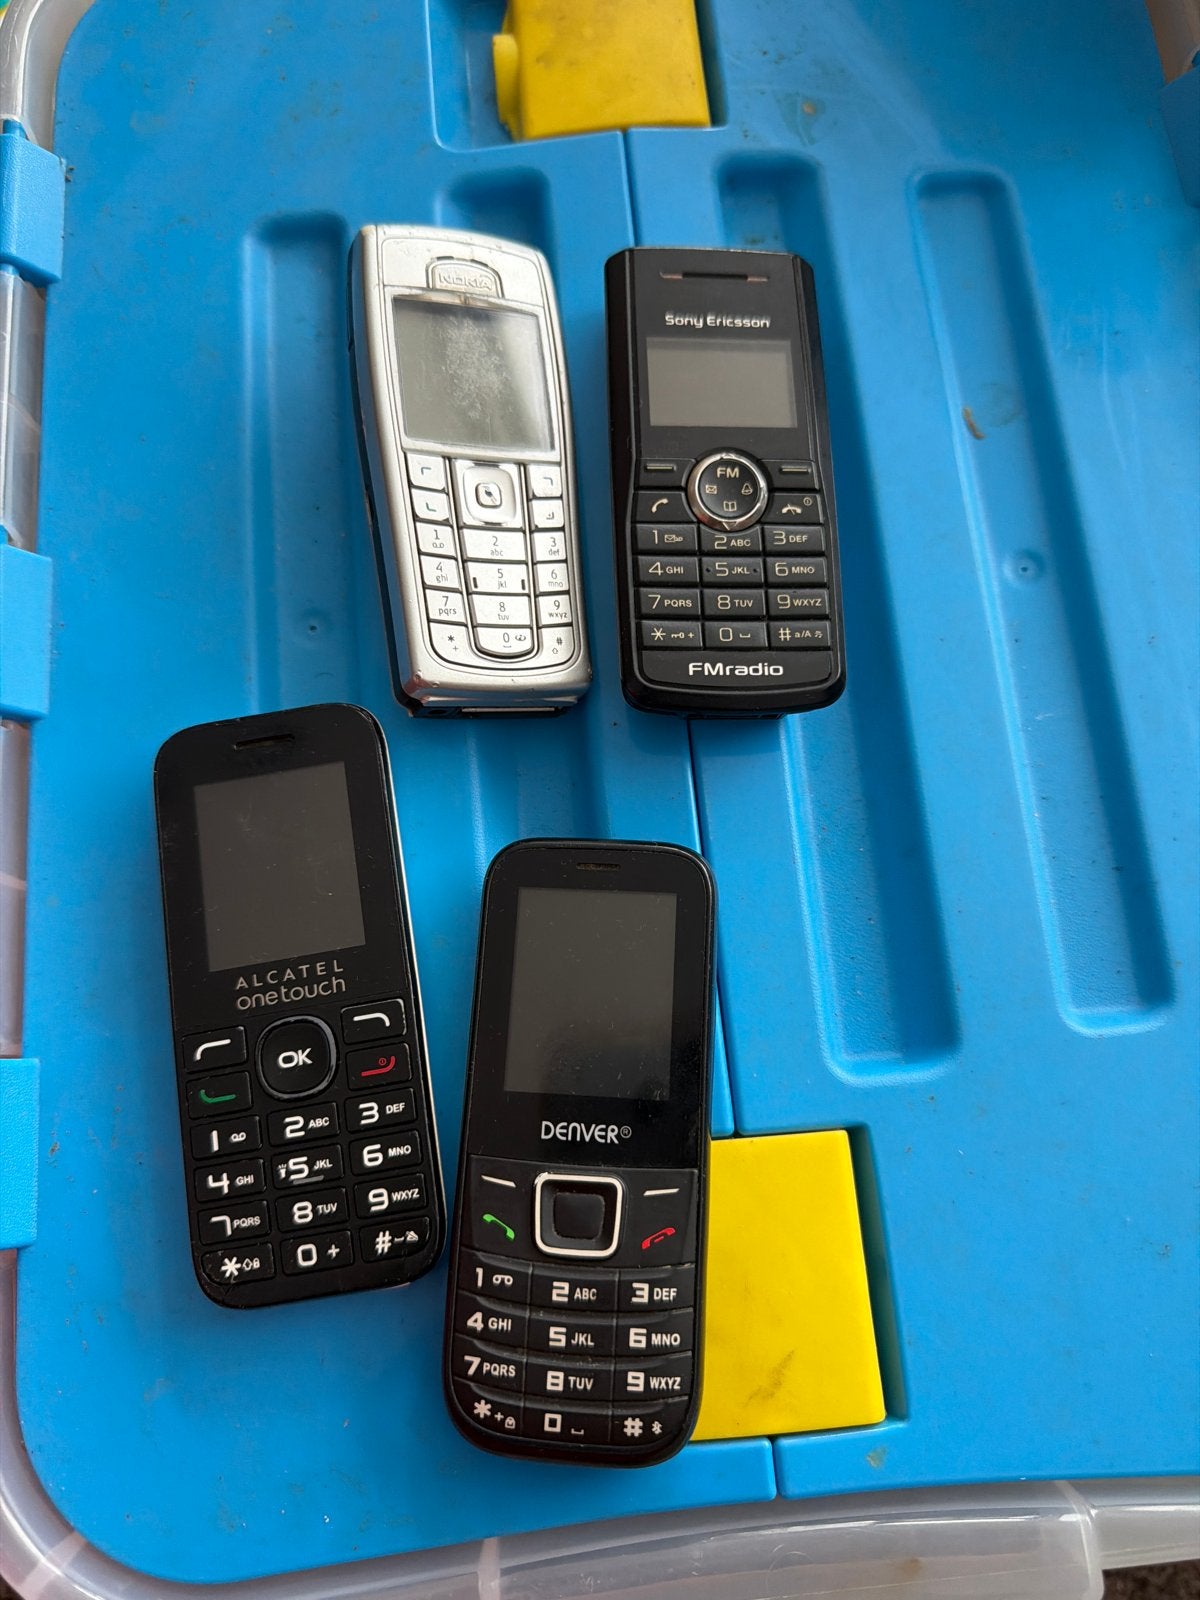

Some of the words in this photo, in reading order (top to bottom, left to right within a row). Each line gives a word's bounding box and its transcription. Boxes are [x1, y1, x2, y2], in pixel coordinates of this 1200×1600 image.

[438, 272, 494, 290] NOKIA
[665, 312, 704, 329] Sony
[706, 313, 771, 329] Ericsson
[716, 467, 739, 479] FM
[492, 536, 498, 546] 2
[550, 537, 557, 547] 3
[652, 530, 658, 545] 1
[715, 536, 727, 549] 2
[730, 539, 751, 547] ABC
[773, 531, 786, 545] 3
[436, 561, 443, 573] 4
[497, 568, 504, 579] 5
[551, 569, 557, 579] 6
[648, 562, 663, 575] 4
[666, 566, 684, 574] GHI
[715, 562, 729, 576] 5
[732, 566, 749, 574] JKL
[775, 562, 789, 576] 6
[791, 566, 815, 574] MNO
[438, 606, 457, 615] pqrs
[442, 596, 449, 607] 7
[499, 602, 506, 612] 8
[553, 600, 560, 610] 9
[648, 594, 661, 609] 7
[717, 595, 730, 609] 8
[777, 594, 790, 609] 9
[719, 628, 732, 641] 0
[688, 662, 784, 676] FMradio
[235, 960, 344, 990] ALCATEL
[237, 977, 345, 1010] onetouch
[278, 1048, 313, 1069] OK
[358, 1102, 379, 1124] 3
[386, 1103, 406, 1114] DEF
[283, 1116, 305, 1138] 2
[308, 1117, 330, 1128] ABC
[210, 1130, 219, 1152] 1
[363, 1144, 383, 1167] 6
[388, 1145, 411, 1156] MNO
[288, 1156, 309, 1180] 5
[314, 1159, 332, 1170] JKL
[207, 1173, 229, 1194] 4
[235, 1175, 254, 1186] GHI
[368, 1188, 389, 1212] 9
[391, 1188, 420, 1200] WXYZ
[293, 1201, 313, 1224] 8
[317, 1203, 337, 1213] TUV
[210, 1215, 232, 1236] 7
[233, 1216, 261, 1227] PQRS
[297, 1244, 317, 1266] 0
[475, 1267, 484, 1287] 1
[552, 1281, 569, 1303] 2
[574, 1288, 597, 1300] ABC
[631, 1282, 649, 1304] 3
[653, 1288, 677, 1300] DEF
[467, 1312, 484, 1332] 4
[488, 1317, 512, 1330] GHI
[549, 1327, 567, 1348] 5
[571, 1333, 595, 1345] JKL
[629, 1327, 647, 1349] 6
[651, 1333, 681, 1345] MNO
[464, 1355, 482, 1376] 7
[483, 1362, 516, 1377] PQRS
[547, 1371, 564, 1392] 8
[568, 1376, 594, 1390] TUV
[627, 1371, 645, 1392] 9
[650, 1377, 681, 1390] WXYZ
[544, 1413, 562, 1432] 0
